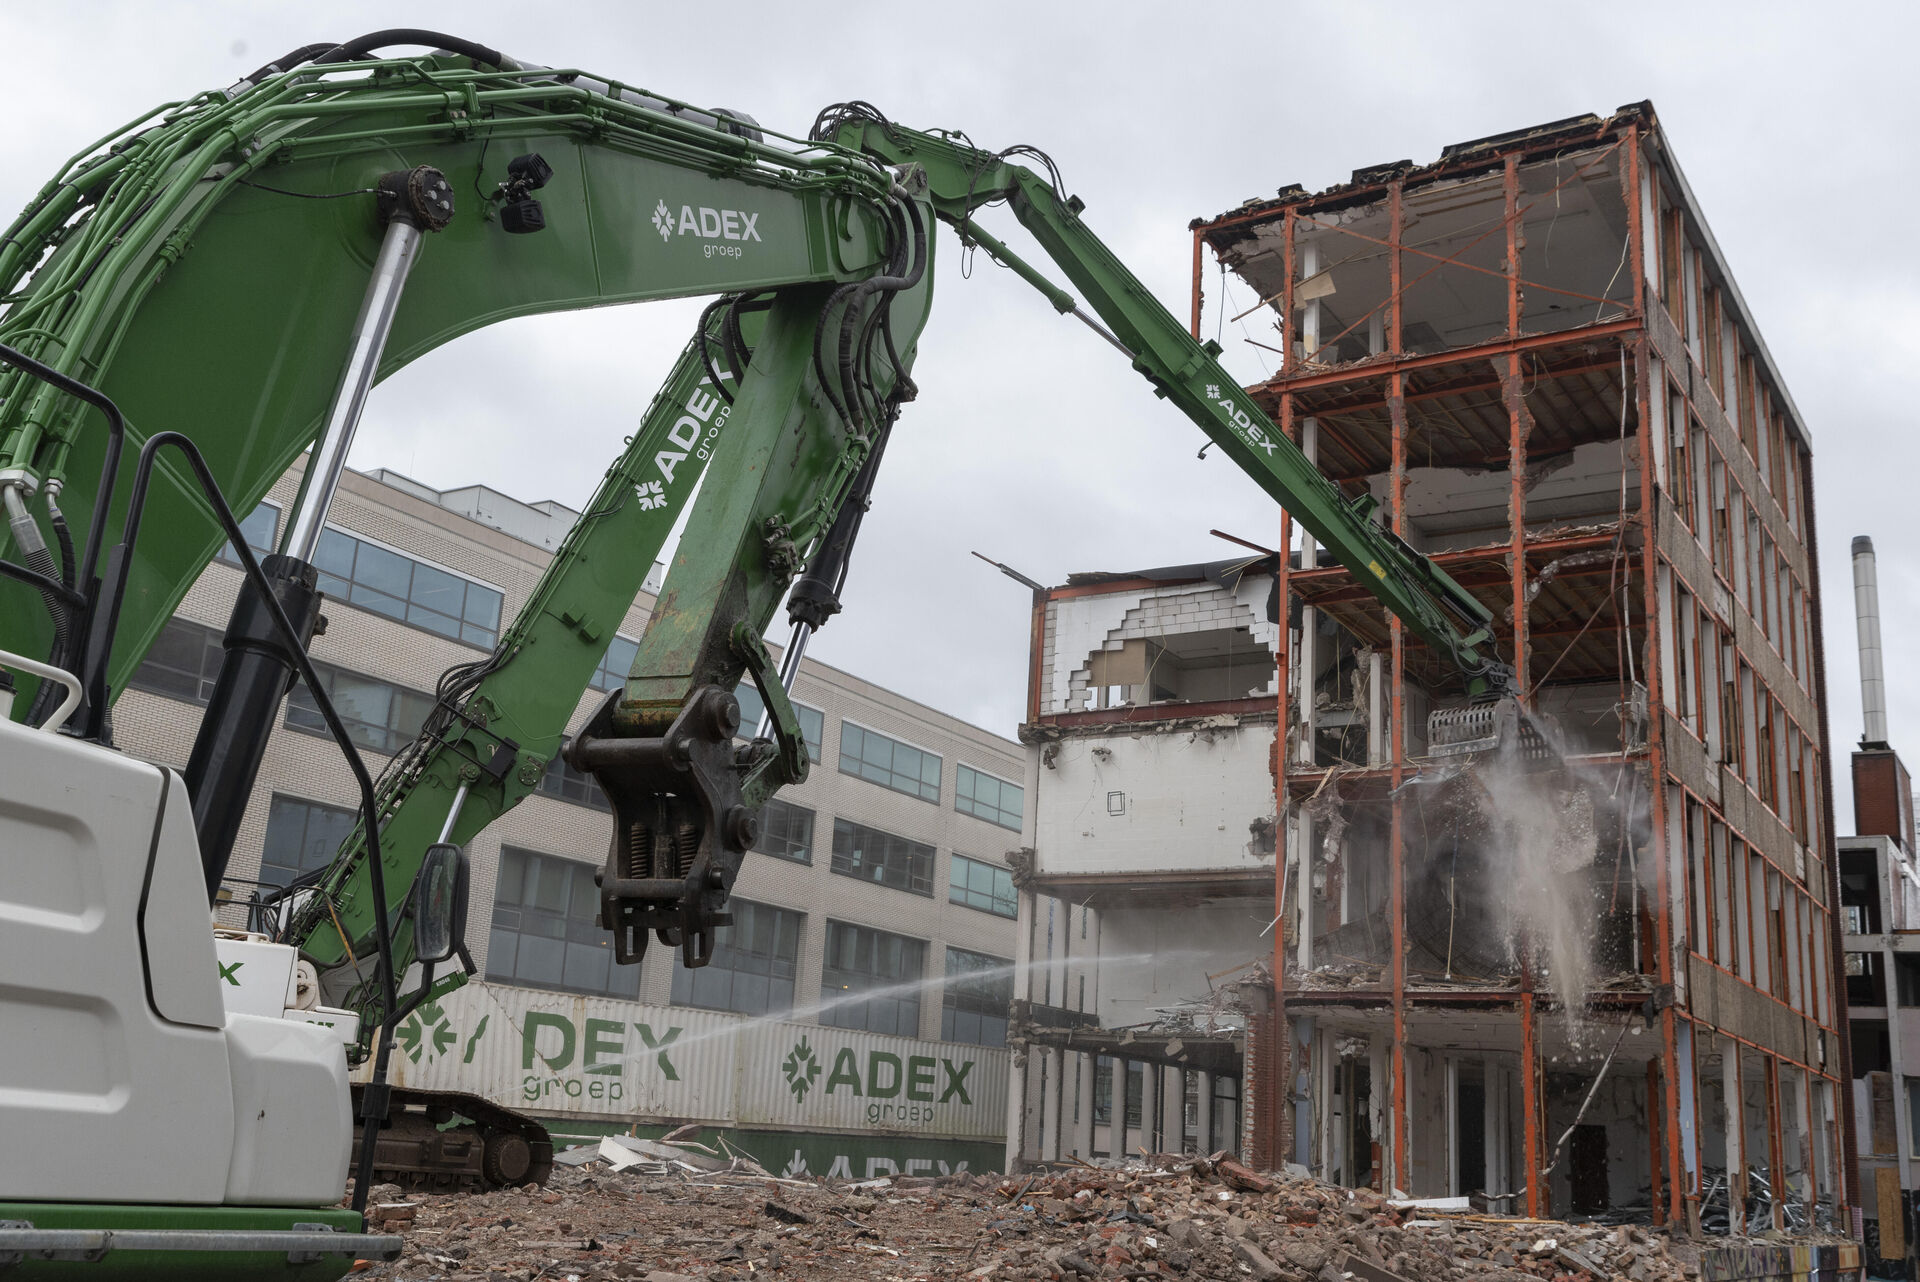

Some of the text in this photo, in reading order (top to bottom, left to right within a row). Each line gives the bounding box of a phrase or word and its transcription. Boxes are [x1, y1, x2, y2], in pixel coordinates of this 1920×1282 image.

[678, 205, 762, 242] ADEX
[703, 244, 742, 260] groep
[697, 406, 731, 460] groep
[1218, 399, 1278, 457] ADEX
[1228, 420, 1256, 447] groep
[463, 1011, 684, 1081] DEX
[523, 1075, 624, 1105] groep
[825, 1047, 975, 1105] ADEX
[867, 1103, 934, 1127] groep
